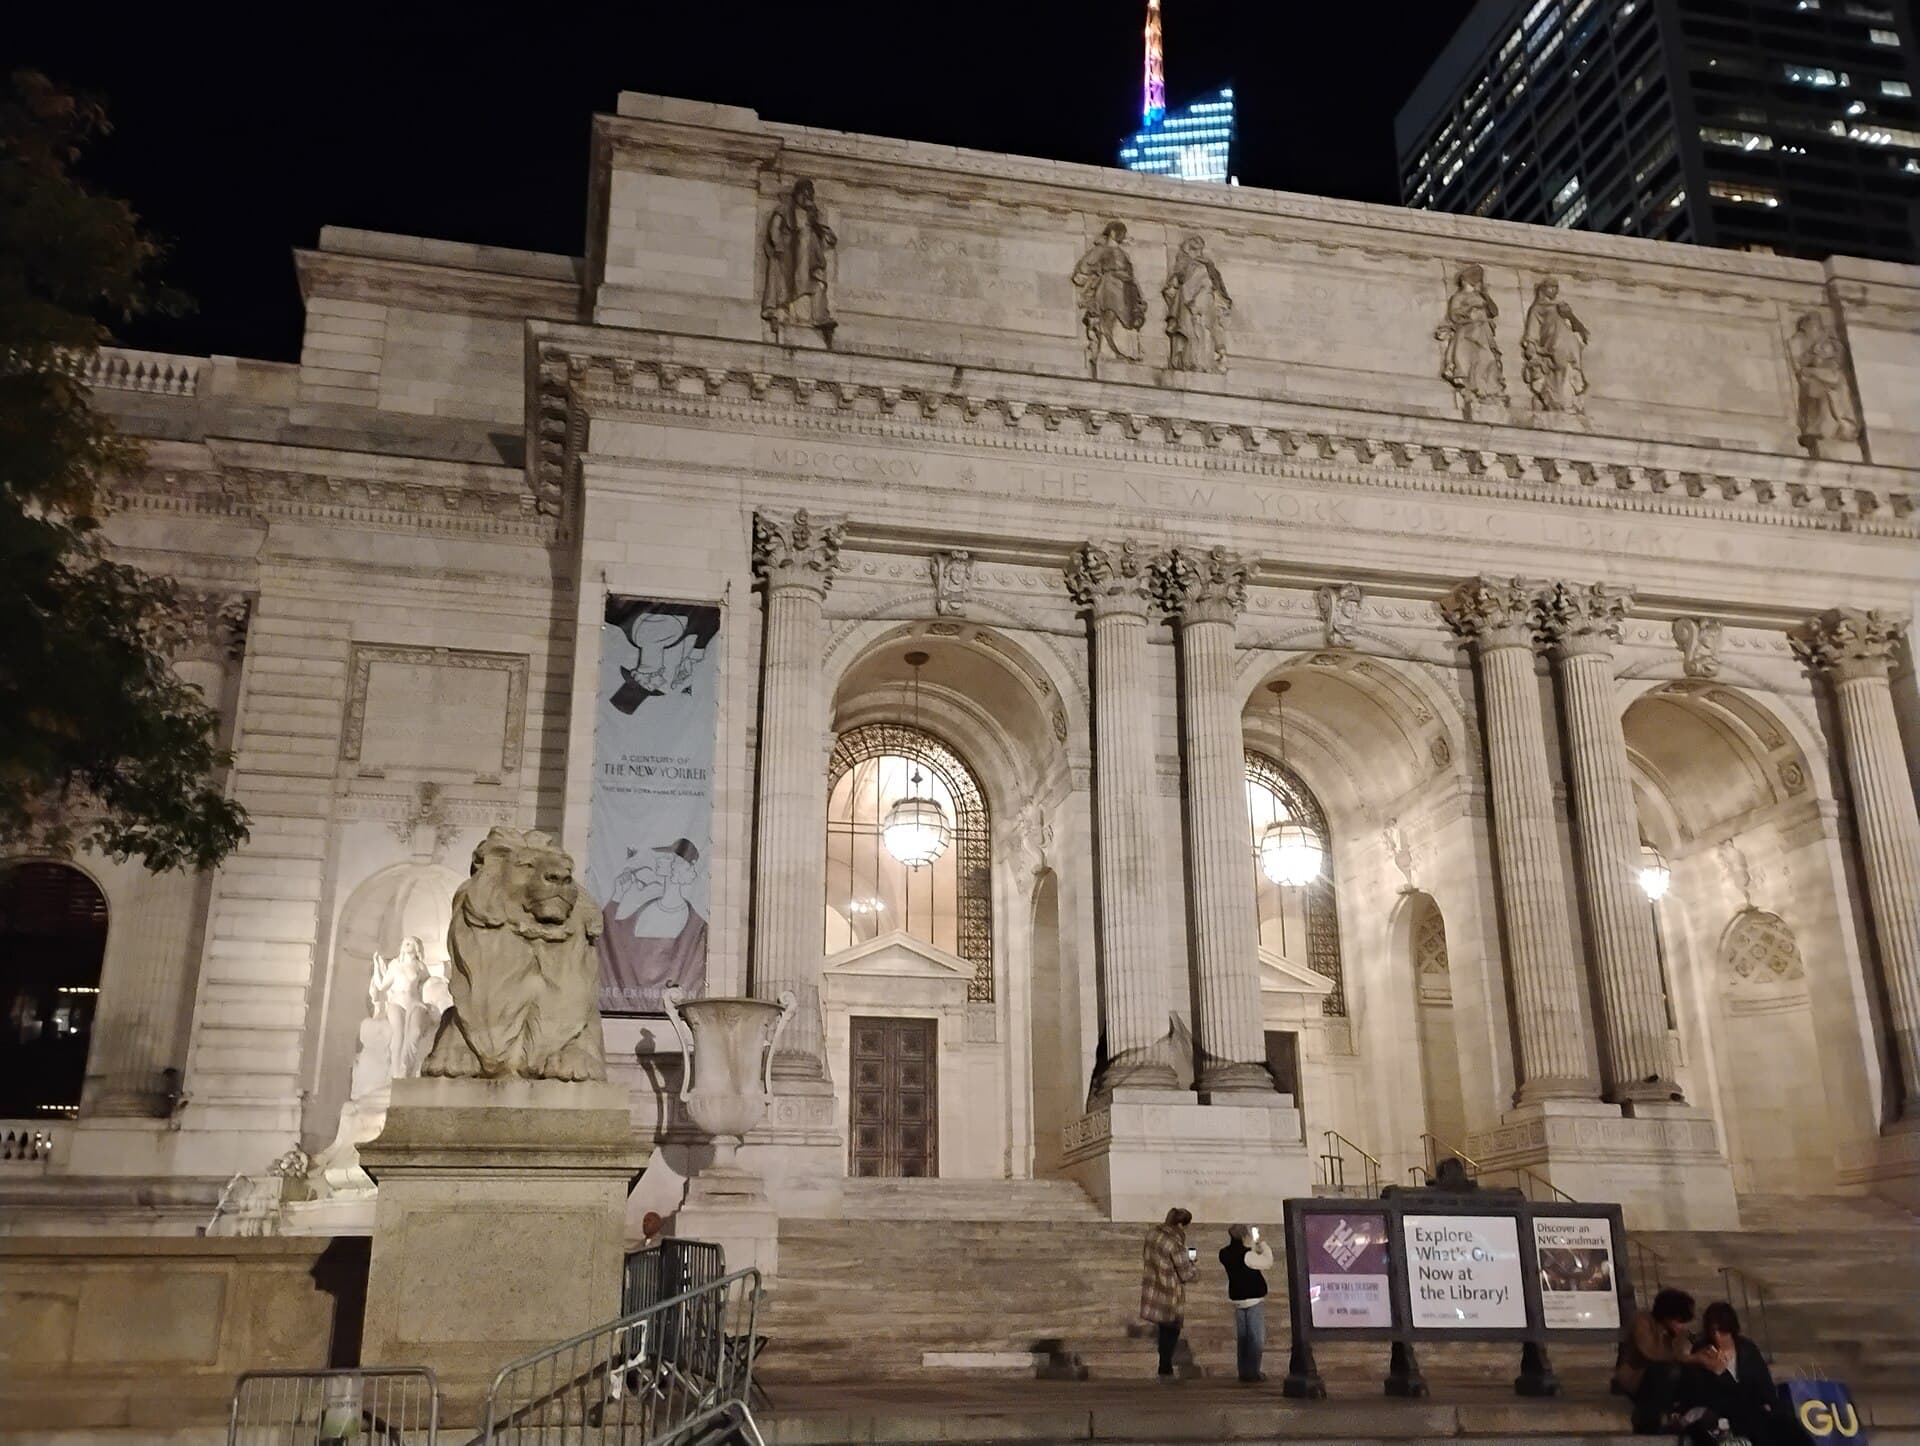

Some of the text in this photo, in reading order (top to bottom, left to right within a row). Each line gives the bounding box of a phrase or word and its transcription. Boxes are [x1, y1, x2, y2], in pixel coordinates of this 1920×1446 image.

[771, 446, 1685, 556] MDCCCXCV THE NEW YORK PUBLIC LIBRARY
[629, 754, 674, 764] CENTURY
[676, 757, 690, 765] OF
[604, 763, 707, 781] THE NEW YORKER
[1415, 1224, 1473, 1247] Explore
[1537, 1223, 1590, 1234] Discover an
[1538, 1235, 1559, 1245] NYC
[1415, 1246, 1467, 1262] What's
[1418, 1265, 1474, 1281] Now at
[1420, 1282, 1510, 1306] the Library!
[1800, 1400, 1859, 1437] GU
